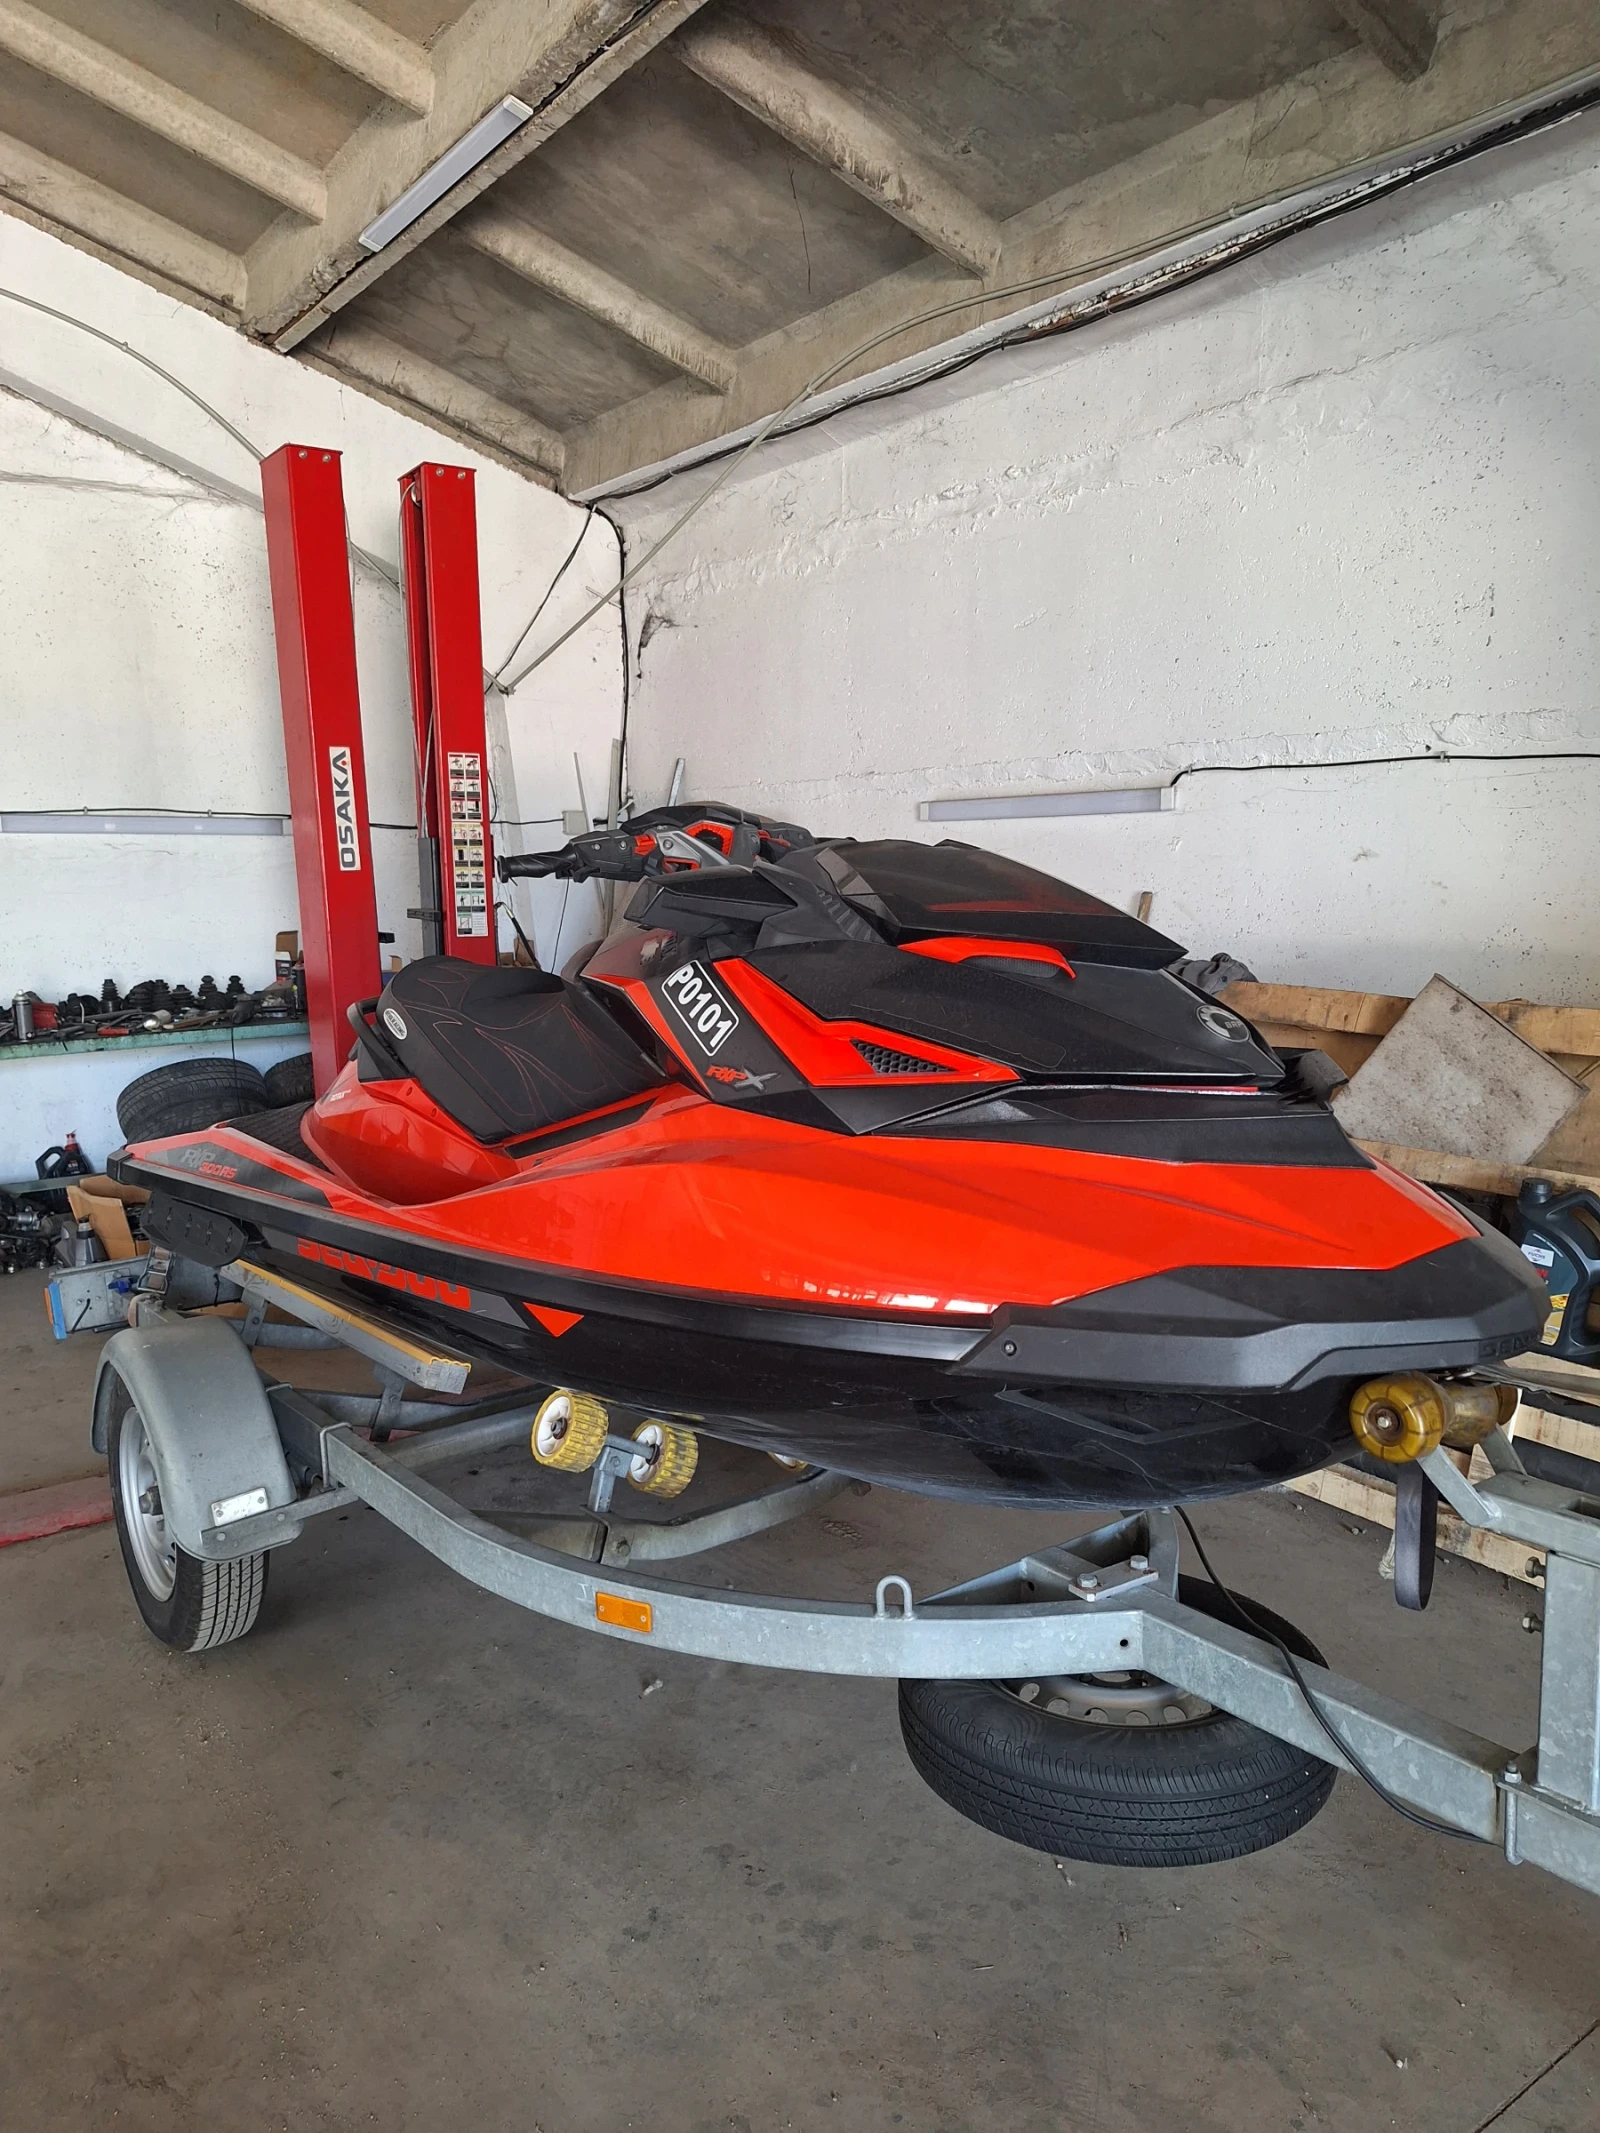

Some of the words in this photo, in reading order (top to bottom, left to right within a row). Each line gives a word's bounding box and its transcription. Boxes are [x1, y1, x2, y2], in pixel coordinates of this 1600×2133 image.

[332, 749, 357, 869] OSAKA
[667, 963, 733, 1048] P0101
[1527, 1251, 1546, 1260] FUCHS
